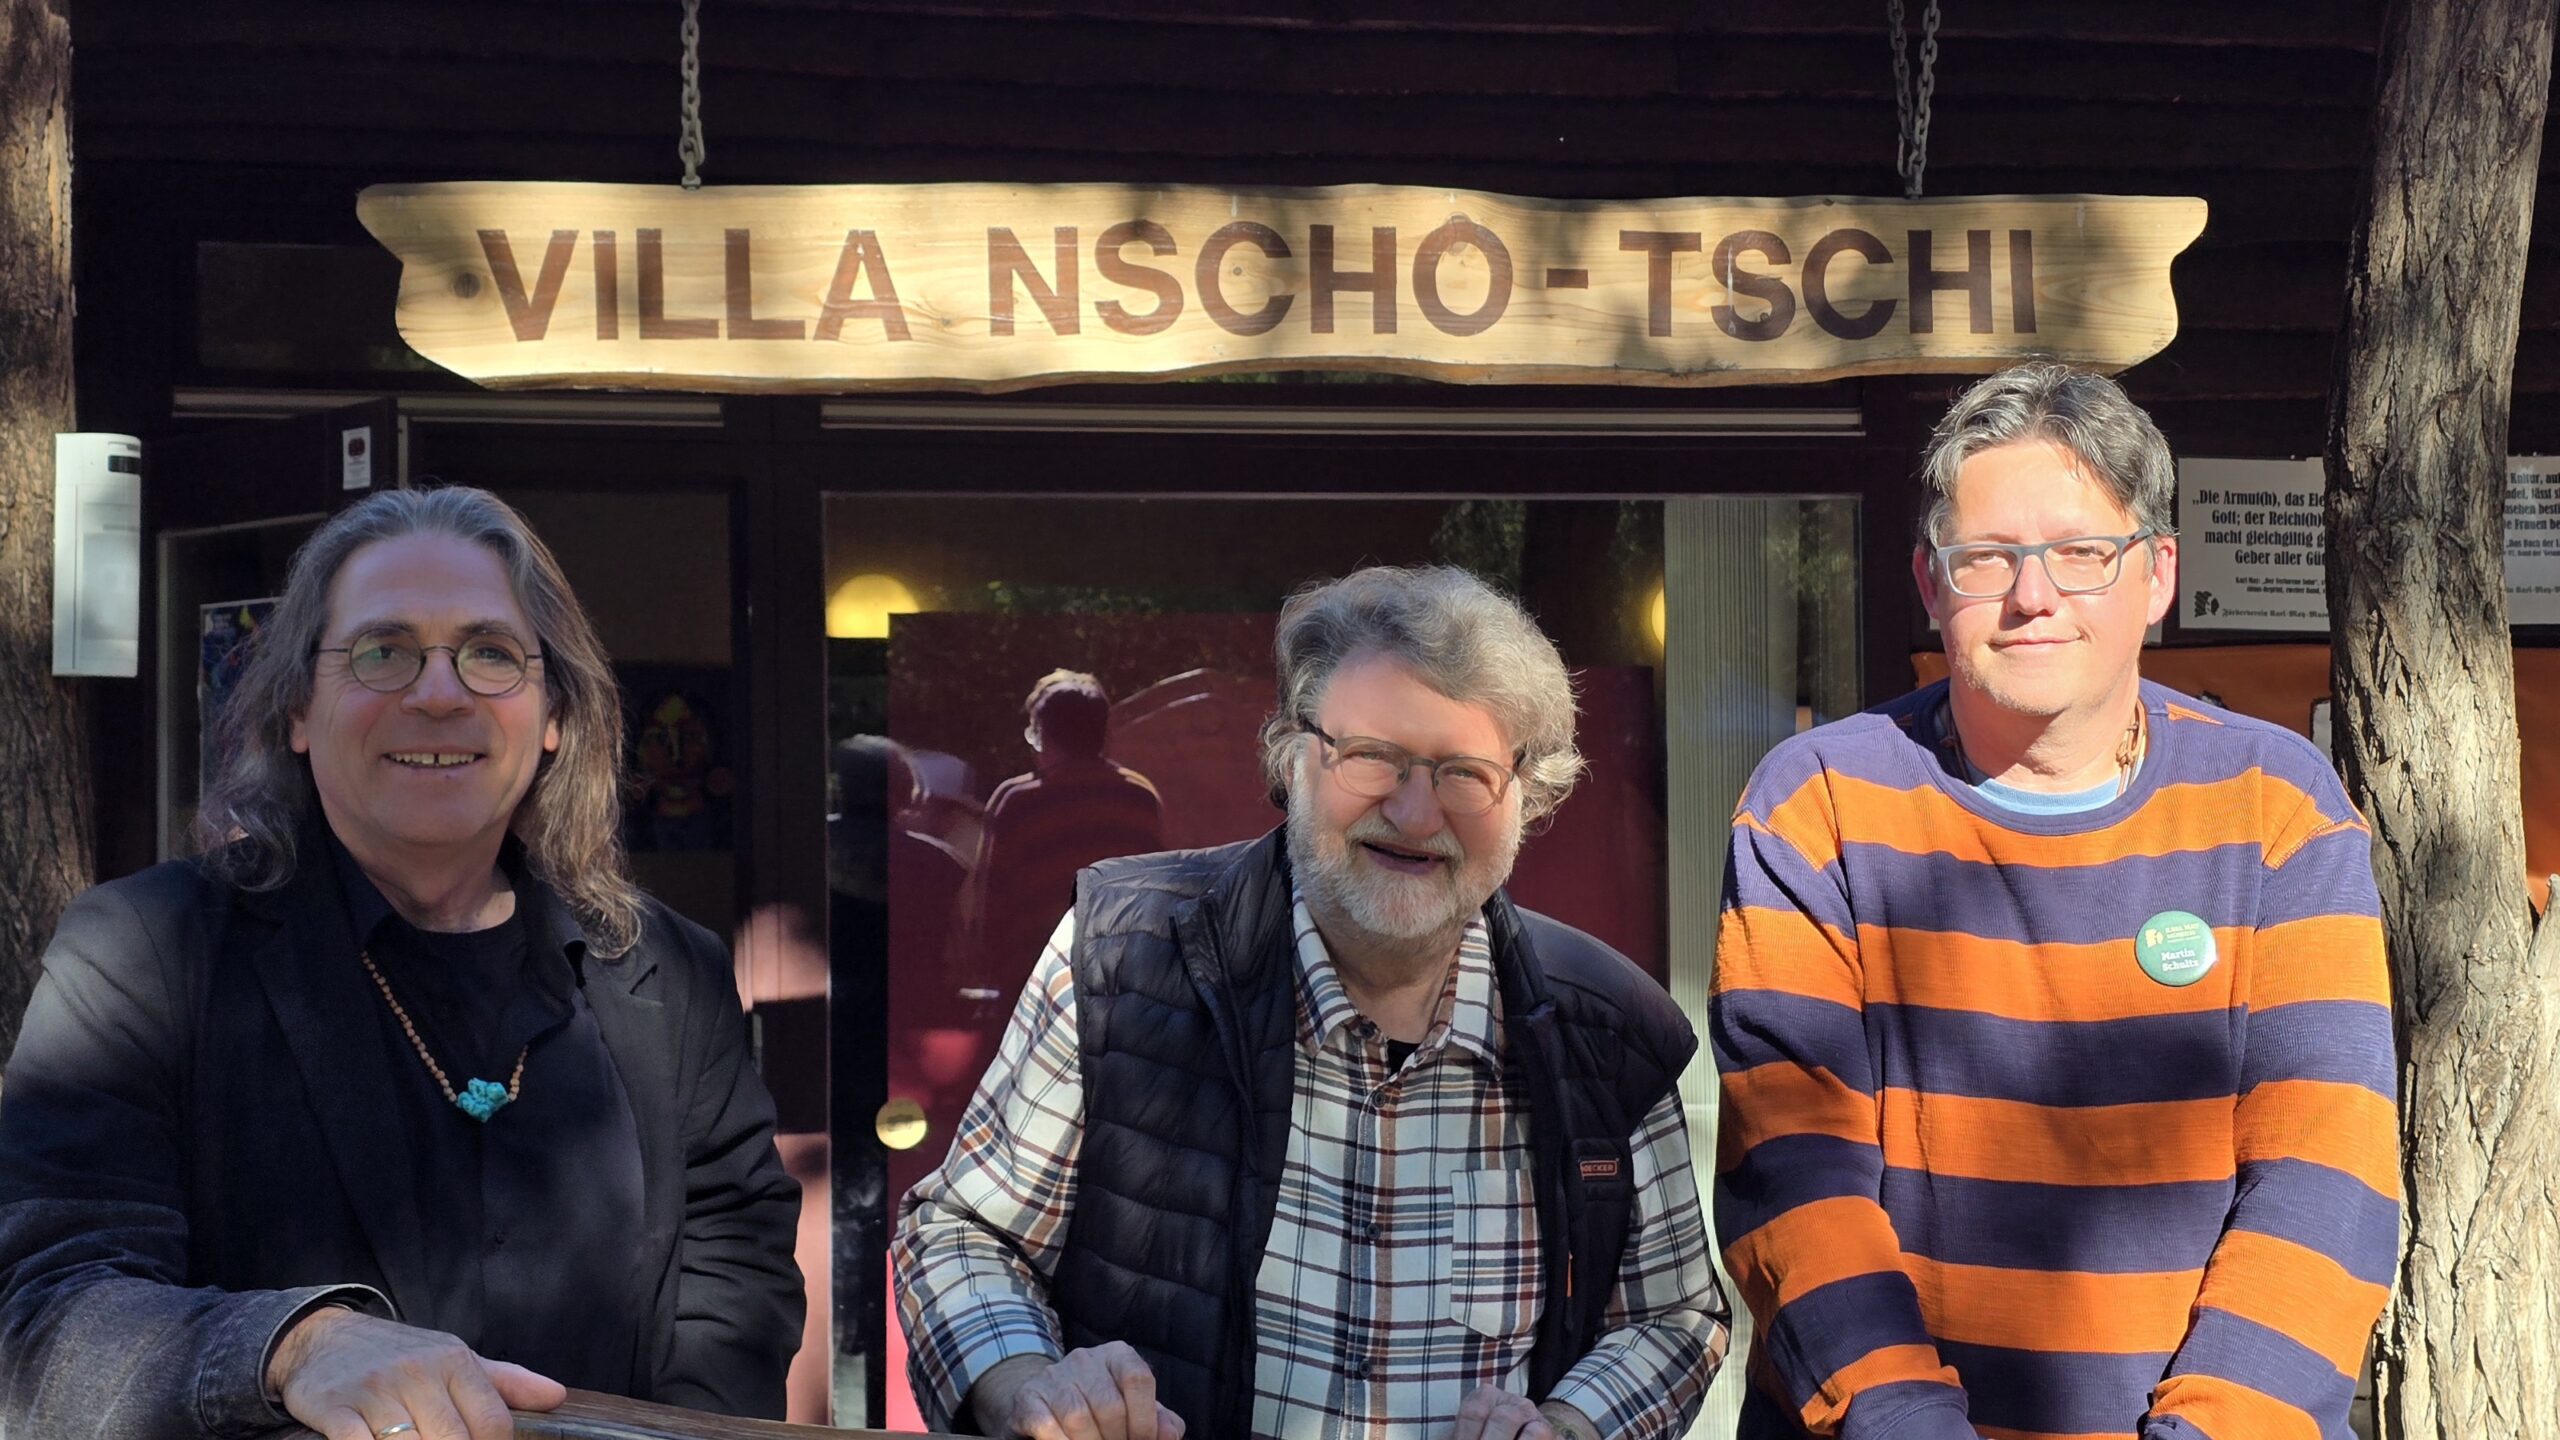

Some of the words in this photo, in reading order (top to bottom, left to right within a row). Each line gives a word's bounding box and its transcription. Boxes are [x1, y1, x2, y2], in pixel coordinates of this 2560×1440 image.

[476, 227, 912, 342] VILLA
[2284, 492, 2305, 506] das
[2212, 510, 2241, 525] Gott;
[2244, 511, 2265, 525] der
[2205, 530, 2242, 544] macht
[2235, 550, 2270, 564] Geber
[2274, 551, 2302, 565] aller
[2161, 948, 2196, 961] Martin
